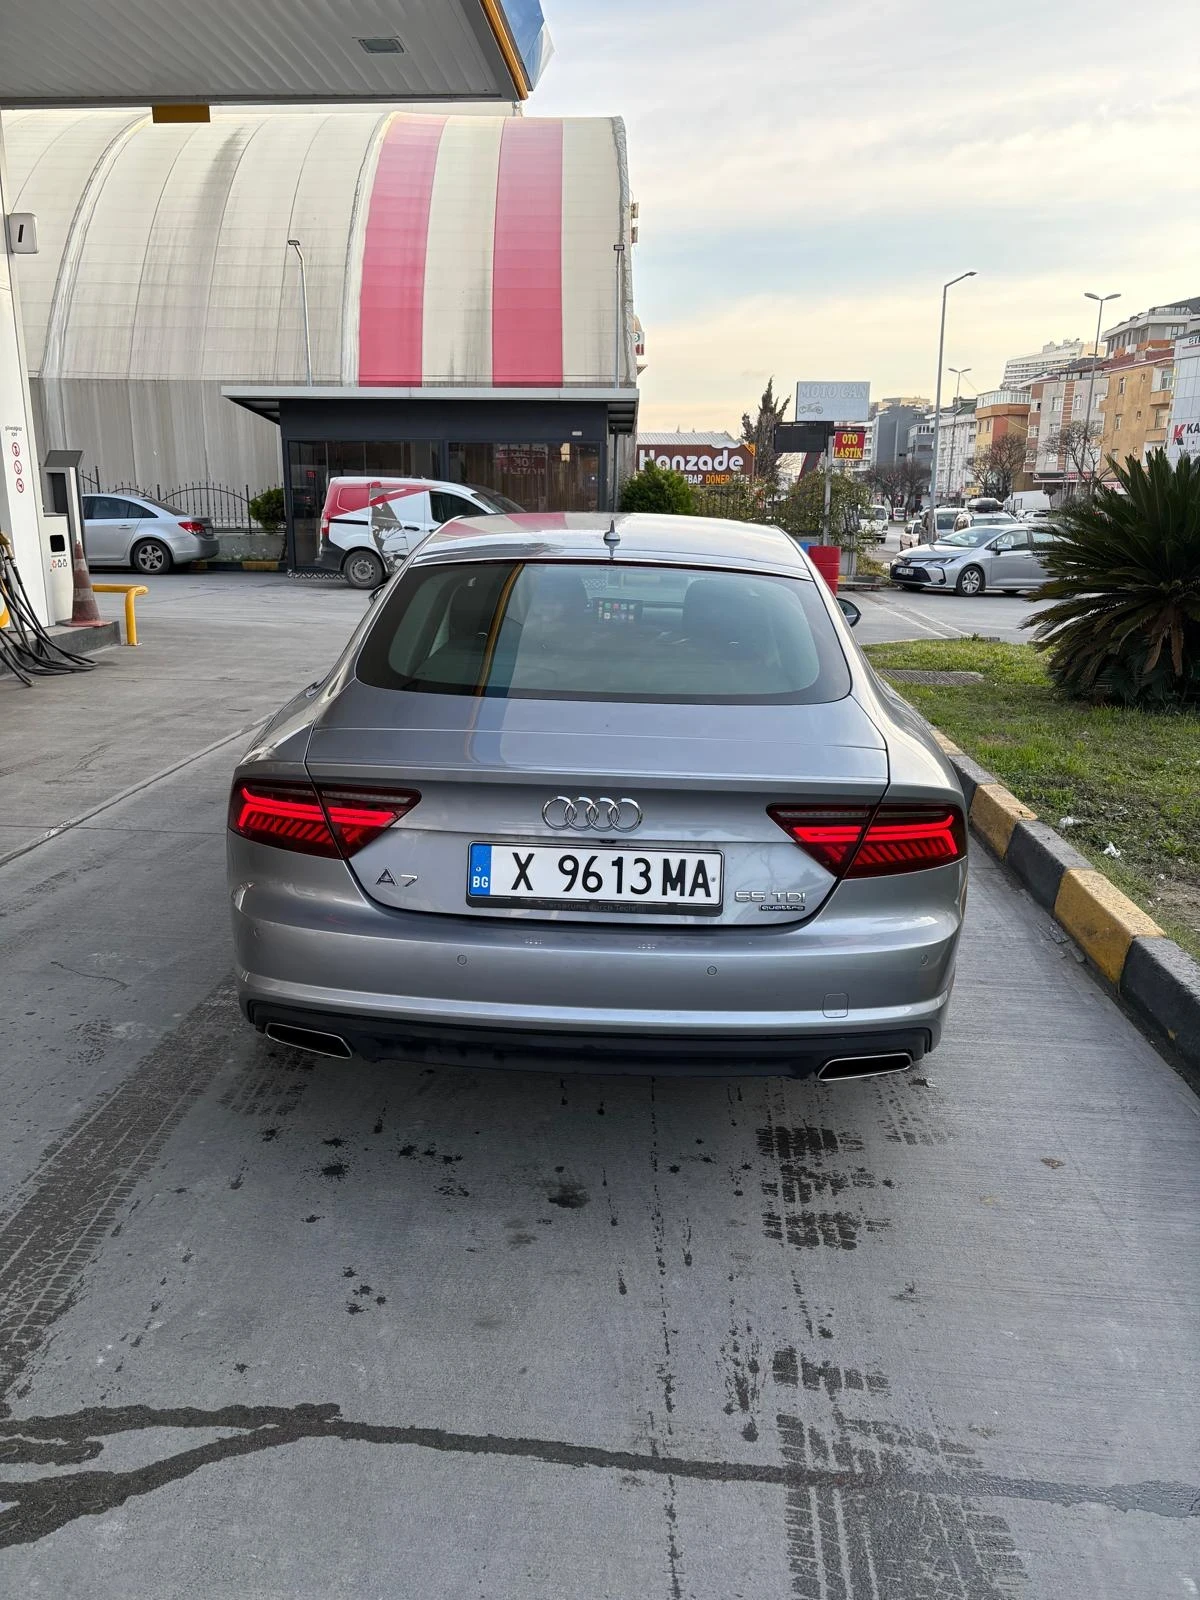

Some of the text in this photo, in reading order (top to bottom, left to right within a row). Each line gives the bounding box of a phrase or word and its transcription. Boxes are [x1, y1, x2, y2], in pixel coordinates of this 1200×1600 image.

[800, 384, 837, 398] MOTO
[842, 434, 858, 444] OTO
[835, 447, 862, 458] LASTİK
[639, 449, 744, 471] Hanzade
[511, 852, 535, 891] X
[473, 876, 489, 888] BG
[735, 891, 806, 903] 55 TDI
